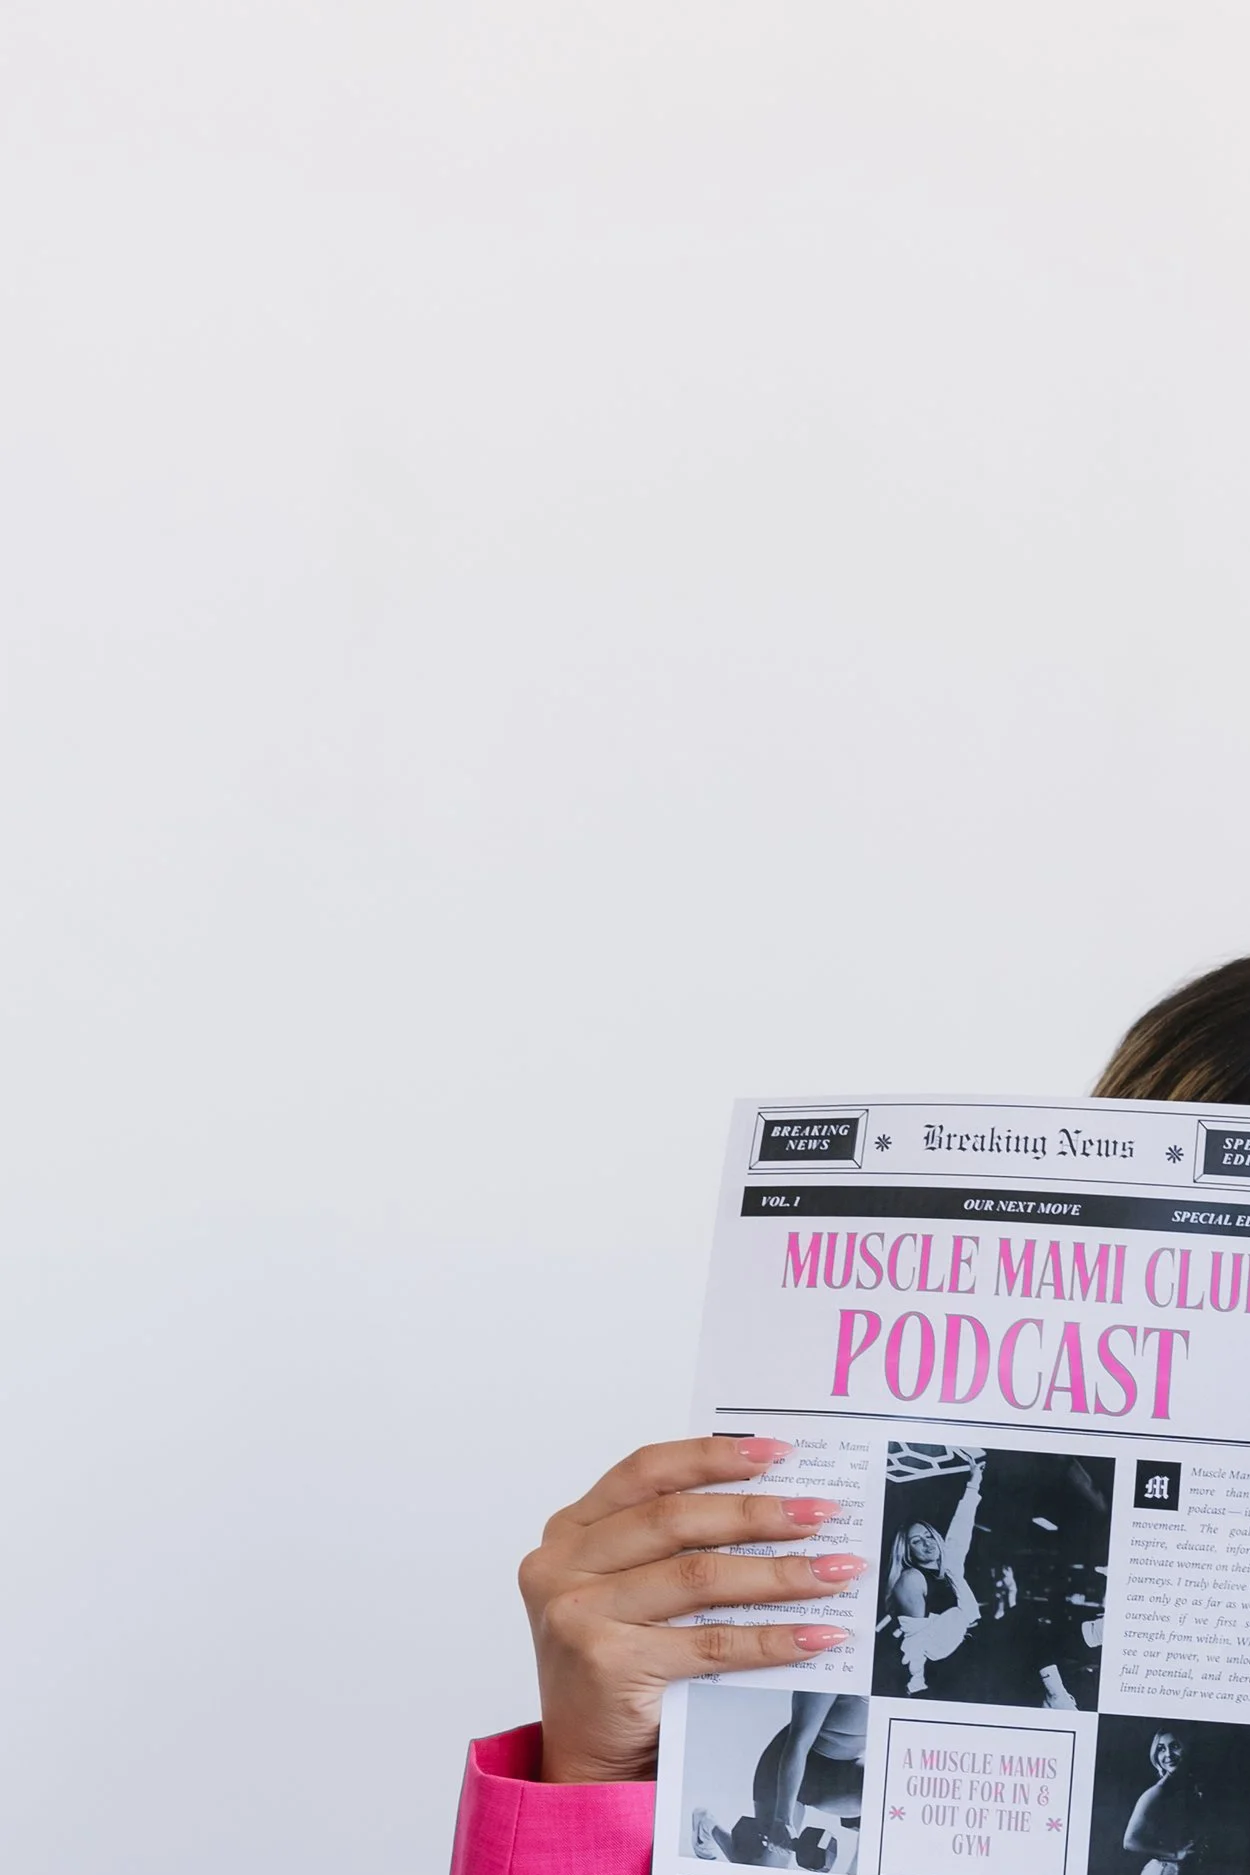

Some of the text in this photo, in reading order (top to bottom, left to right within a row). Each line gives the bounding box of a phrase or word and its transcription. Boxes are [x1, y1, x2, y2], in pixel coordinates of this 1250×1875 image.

[771, 1124, 850, 1138] BREAKING
[785, 1139, 831, 1151] NEWS
[923, 1124, 1135, 1160] Breaking News
[761, 1196, 790, 1207] VOL.
[964, 1198, 1082, 1216] OUR NEXT MOVE
[1172, 1210, 1233, 1227] SPECIAL
[781, 1232, 979, 1295] MUSCLE
[994, 1237, 1127, 1304] MAMI
[830, 1308, 1190, 1420] PODCAST
[794, 1439, 870, 1452] Muscle Mami
[798, 1457, 835, 1468] podcast
[850, 1460, 870, 1470] will
[757, 1472, 861, 1489] feature expert advice,
[1191, 1467, 1226, 1479] Muscle
[1189, 1487, 1215, 1496] more
[1226, 1488, 1250, 1499] than
[1187, 1505, 1226, 1516] podcast
[853, 1518, 863, 1526] at
[1132, 1520, 1187, 1532] movement.
[1200, 1523, 1219, 1534] The
[729, 1544, 777, 1556] physically
[1130, 1537, 1168, 1550] inspire,
[1176, 1541, 1218, 1553] educate,
[1129, 1557, 1175, 1568] motivate
[1177, 1562, 1213, 1571] women
[1215, 1564, 1228, 1572] on
[1126, 1574, 1173, 1587] journeys.
[1184, 1578, 1210, 1591] truly
[1212, 1581, 1248, 1592] believe
[839, 1589, 859, 1599] and
[1126, 1594, 1145, 1602] can
[1148, 1593, 1171, 1605] only
[1174, 1598, 1188, 1607] go
[1191, 1598, 1203, 1606] as
[1204, 1598, 1222, 1609] far
[1225, 1600, 1237, 1608] as
[753, 1603, 808, 1616] community
[810, 1605, 820, 1615] in
[1125, 1611, 1171, 1623] ourselves
[1178, 1613, 1187, 1626] if
[1195, 1617, 1209, 1625] we
[1215, 1616, 1237, 1628] first
[1123, 1629, 1166, 1642] strength
[1166, 1631, 1193, 1643] from
[1196, 1633, 1232, 1646] within.
[845, 1646, 855, 1654] to
[1122, 1648, 1138, 1657] see
[1143, 1650, 1162, 1658] our
[1165, 1651, 1200, 1662] power,
[1206, 1655, 1221, 1663] we
[824, 1663, 834, 1671] to
[842, 1662, 854, 1672] be
[1119, 1665, 1139, 1677] full
[1144, 1667, 1194, 1680] potential,
[1201, 1671, 1222, 1681] and
[1120, 1683, 1250, 1704] limit to how far we can go.
[903, 1748, 1057, 1779] A MUSCLE MAMIS
[906, 1776, 1050, 1806] GUIDE FOR IN &
[921, 1804, 1031, 1833] OUT OF THE
[952, 1834, 991, 1857] GYM
